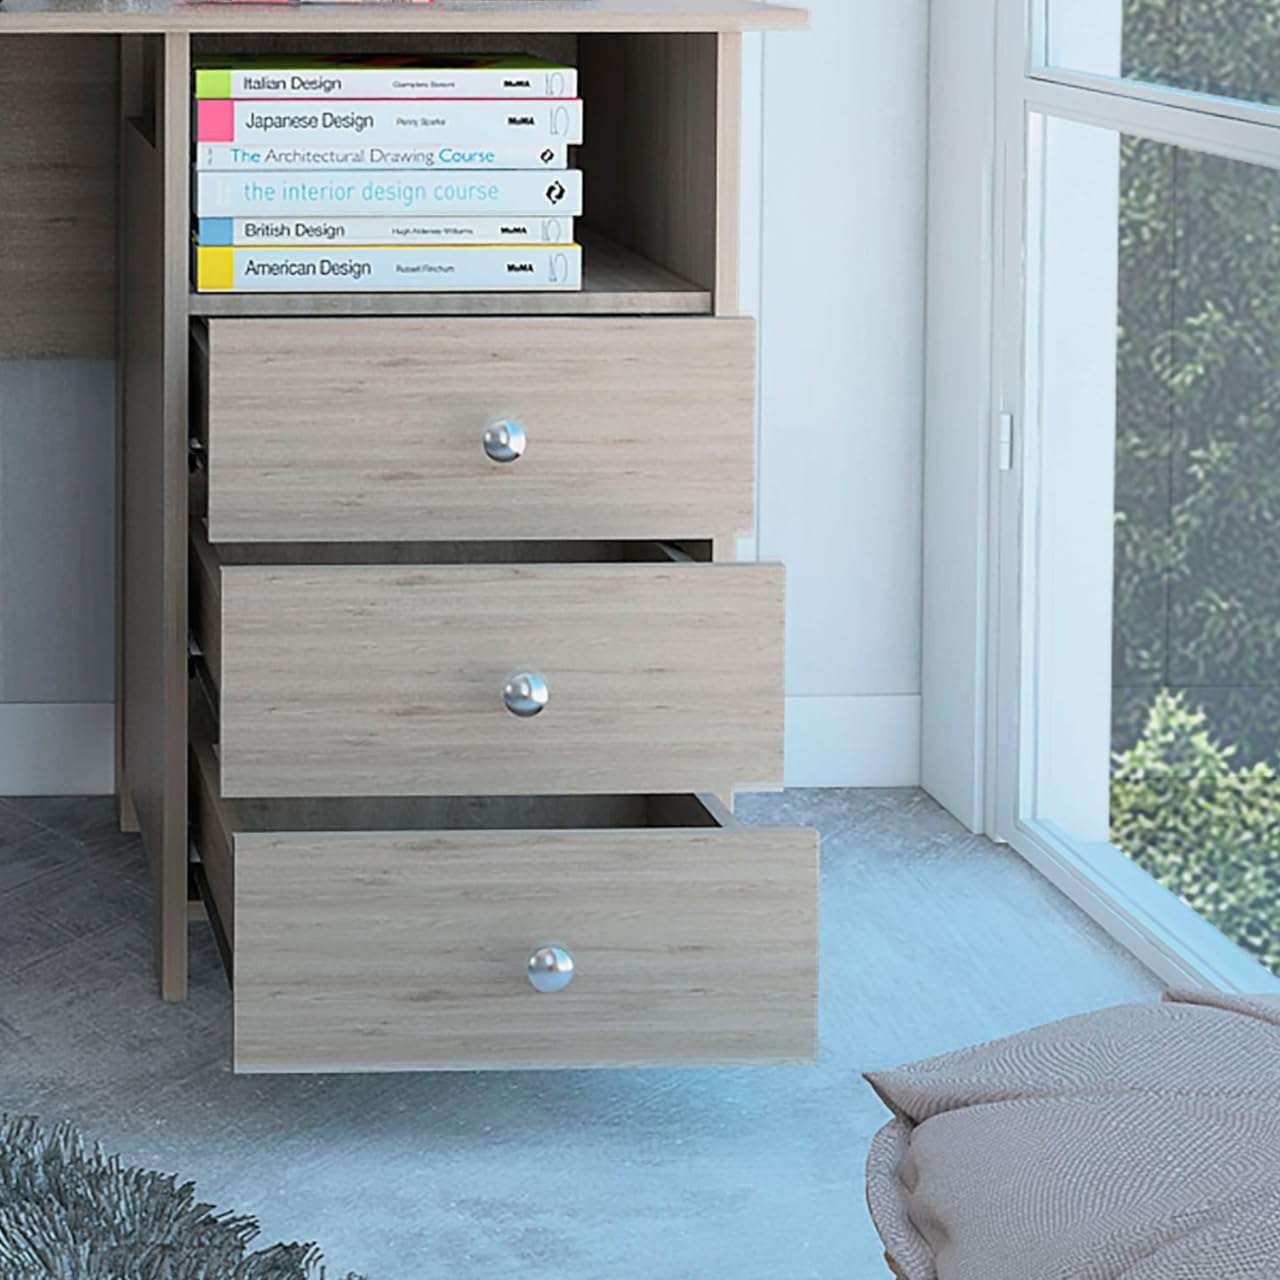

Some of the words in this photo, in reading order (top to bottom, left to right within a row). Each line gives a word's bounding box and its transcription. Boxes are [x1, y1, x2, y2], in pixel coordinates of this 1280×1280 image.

[243, 77, 286, 90] Italian
[291, 76, 341, 92] Design
[245, 112, 318, 131] Japanese
[322, 112, 374, 132] Design
[231, 148, 261, 163] The
[264, 148, 364, 163] Architectural
[370, 148, 435, 167] Drawing
[439, 148, 495, 163] Course
[243, 182, 275, 201] the
[282, 182, 354, 201] interior
[361, 182, 426, 207] design
[433, 184, 500, 201] course
[245, 223, 291, 237] British
[295, 223, 345, 239] Design
[245, 259, 316, 275] American
[320, 259, 371, 279] Design
